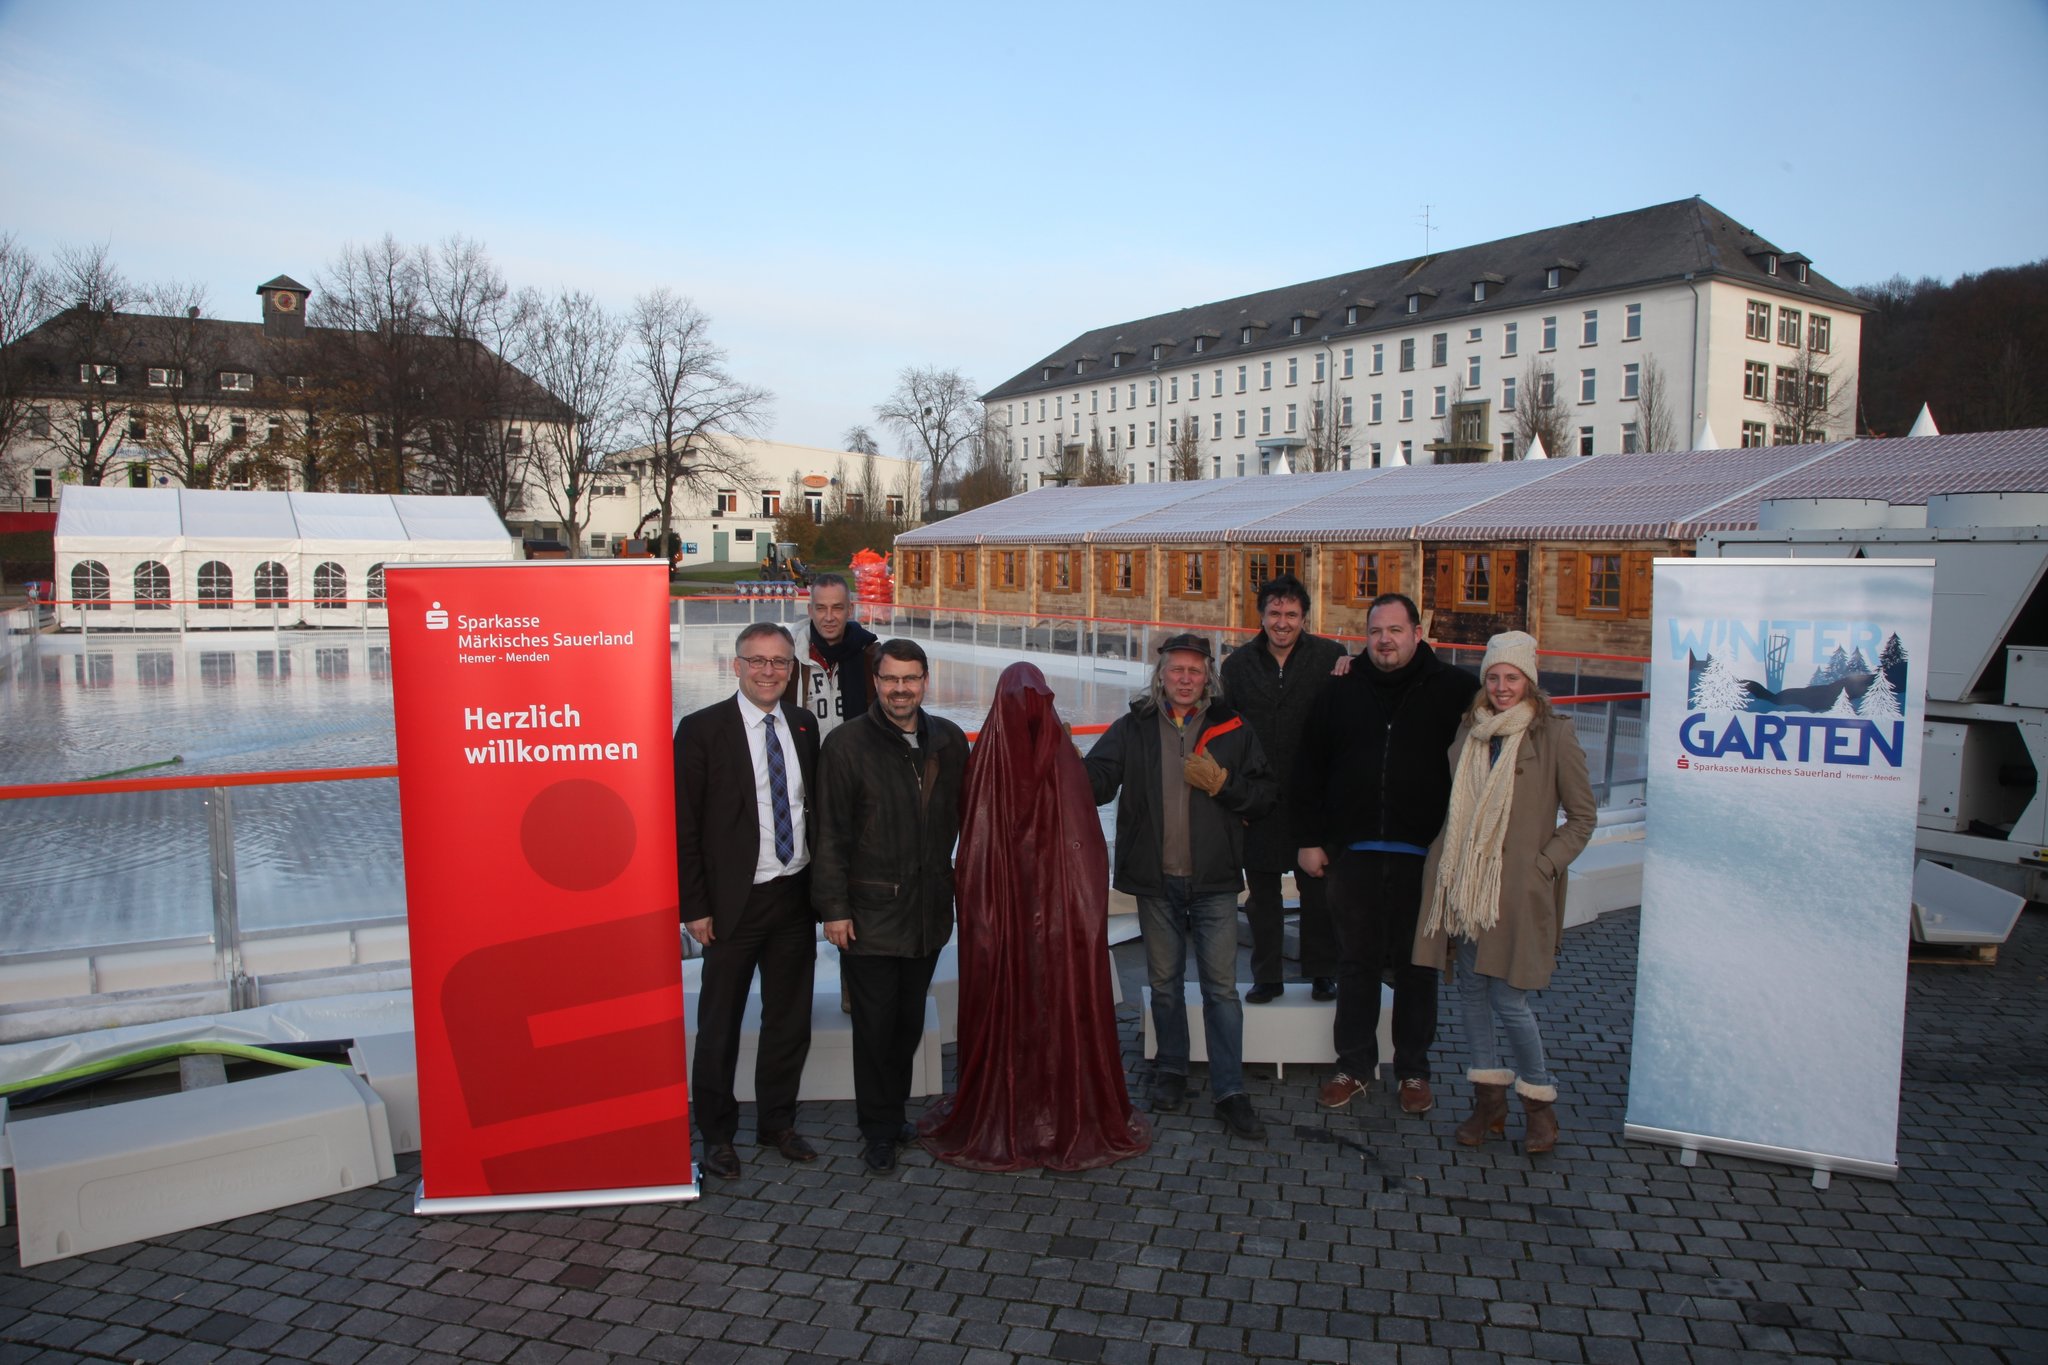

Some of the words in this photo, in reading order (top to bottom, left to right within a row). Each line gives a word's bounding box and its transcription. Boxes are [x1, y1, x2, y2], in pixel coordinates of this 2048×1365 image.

[457, 614, 540, 631] Sparkasse
[458, 632, 549, 648] Märkisches
[553, 631, 634, 647] Sauerland
[1668, 618, 1884, 665] WINTER
[459, 653, 496, 664] Hemer
[505, 652, 550, 663] Menden
[464, 704, 581, 730] Herzlich
[1679, 713, 1905, 767] GARTEN
[464, 739, 638, 764] willkommen
[1693, 762, 1739, 773] Sparkasse
[1741, 764, 1792, 776] Märkisches
[1794, 768, 1842, 779] Sauerland
[1874, 774, 1902, 782] Menden
